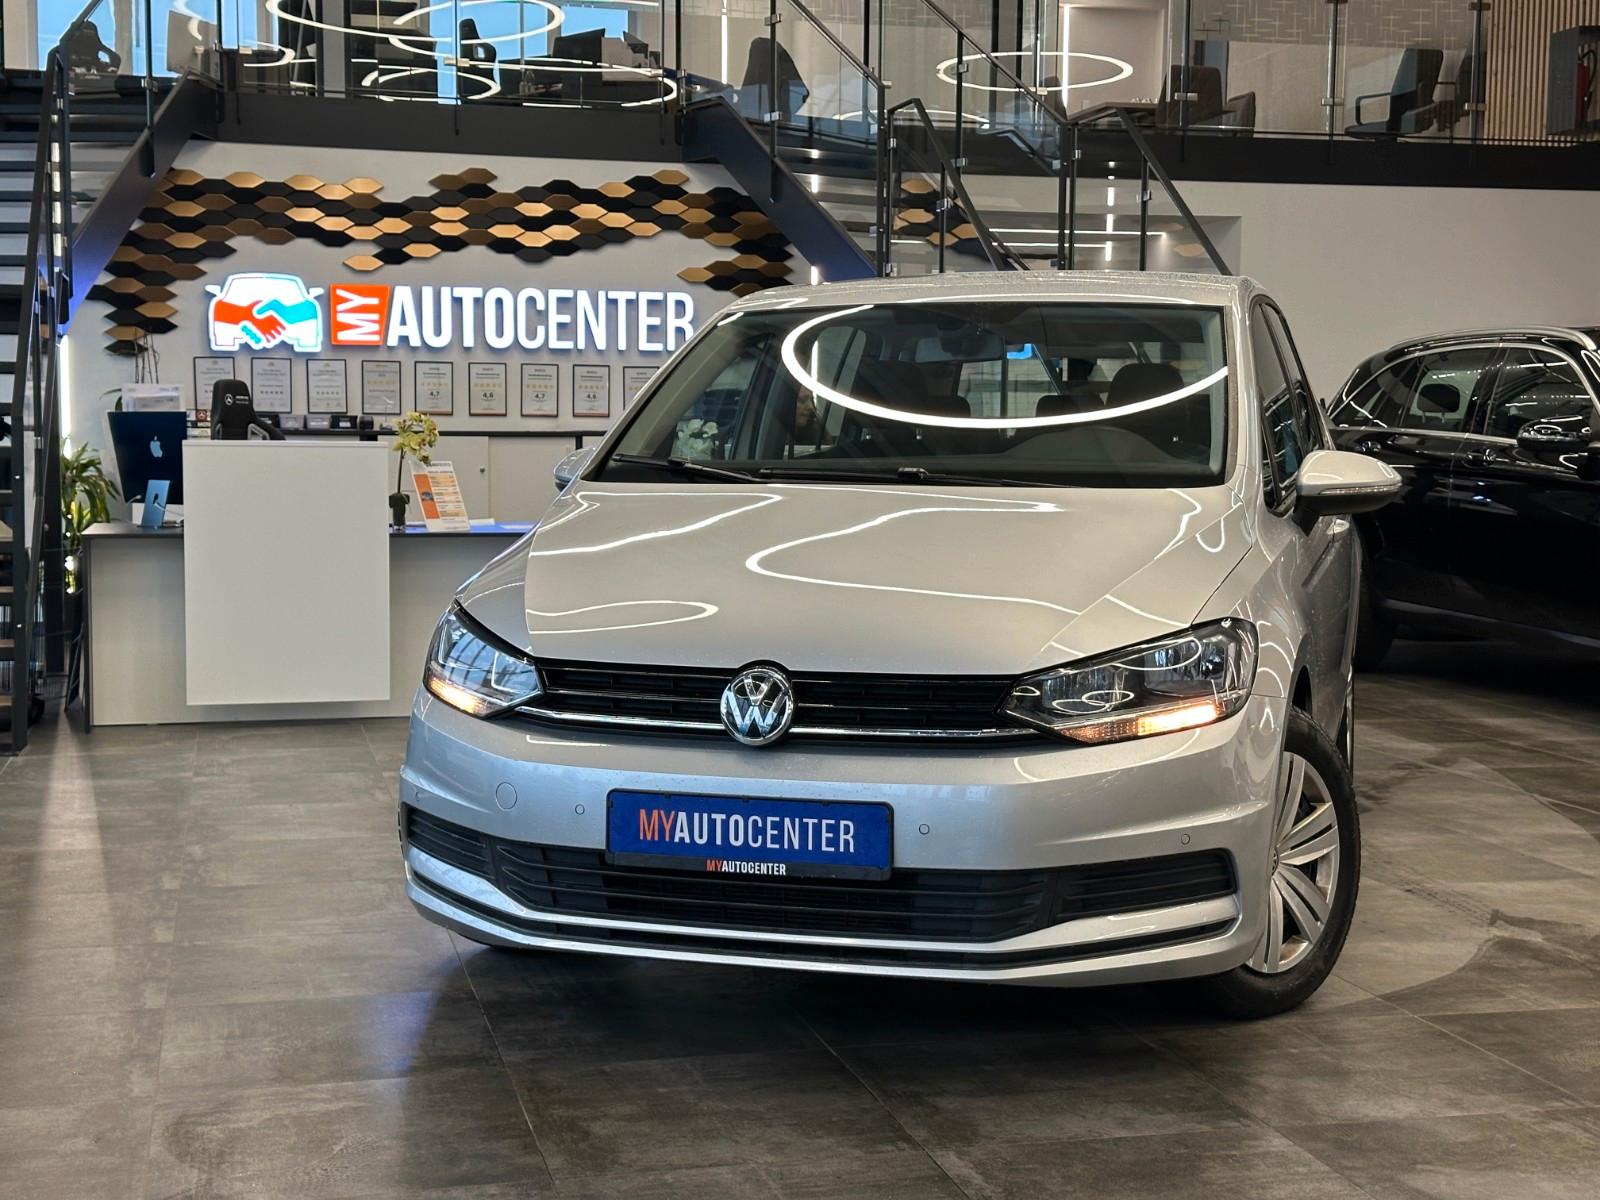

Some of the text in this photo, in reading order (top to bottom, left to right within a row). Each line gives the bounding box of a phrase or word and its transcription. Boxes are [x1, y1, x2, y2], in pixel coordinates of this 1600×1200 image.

[336, 285, 694, 351] MY AUTOCENTER
[638, 808, 855, 853] MYAUTOCENTER
[706, 859, 787, 876] MYAUTOCENTER
